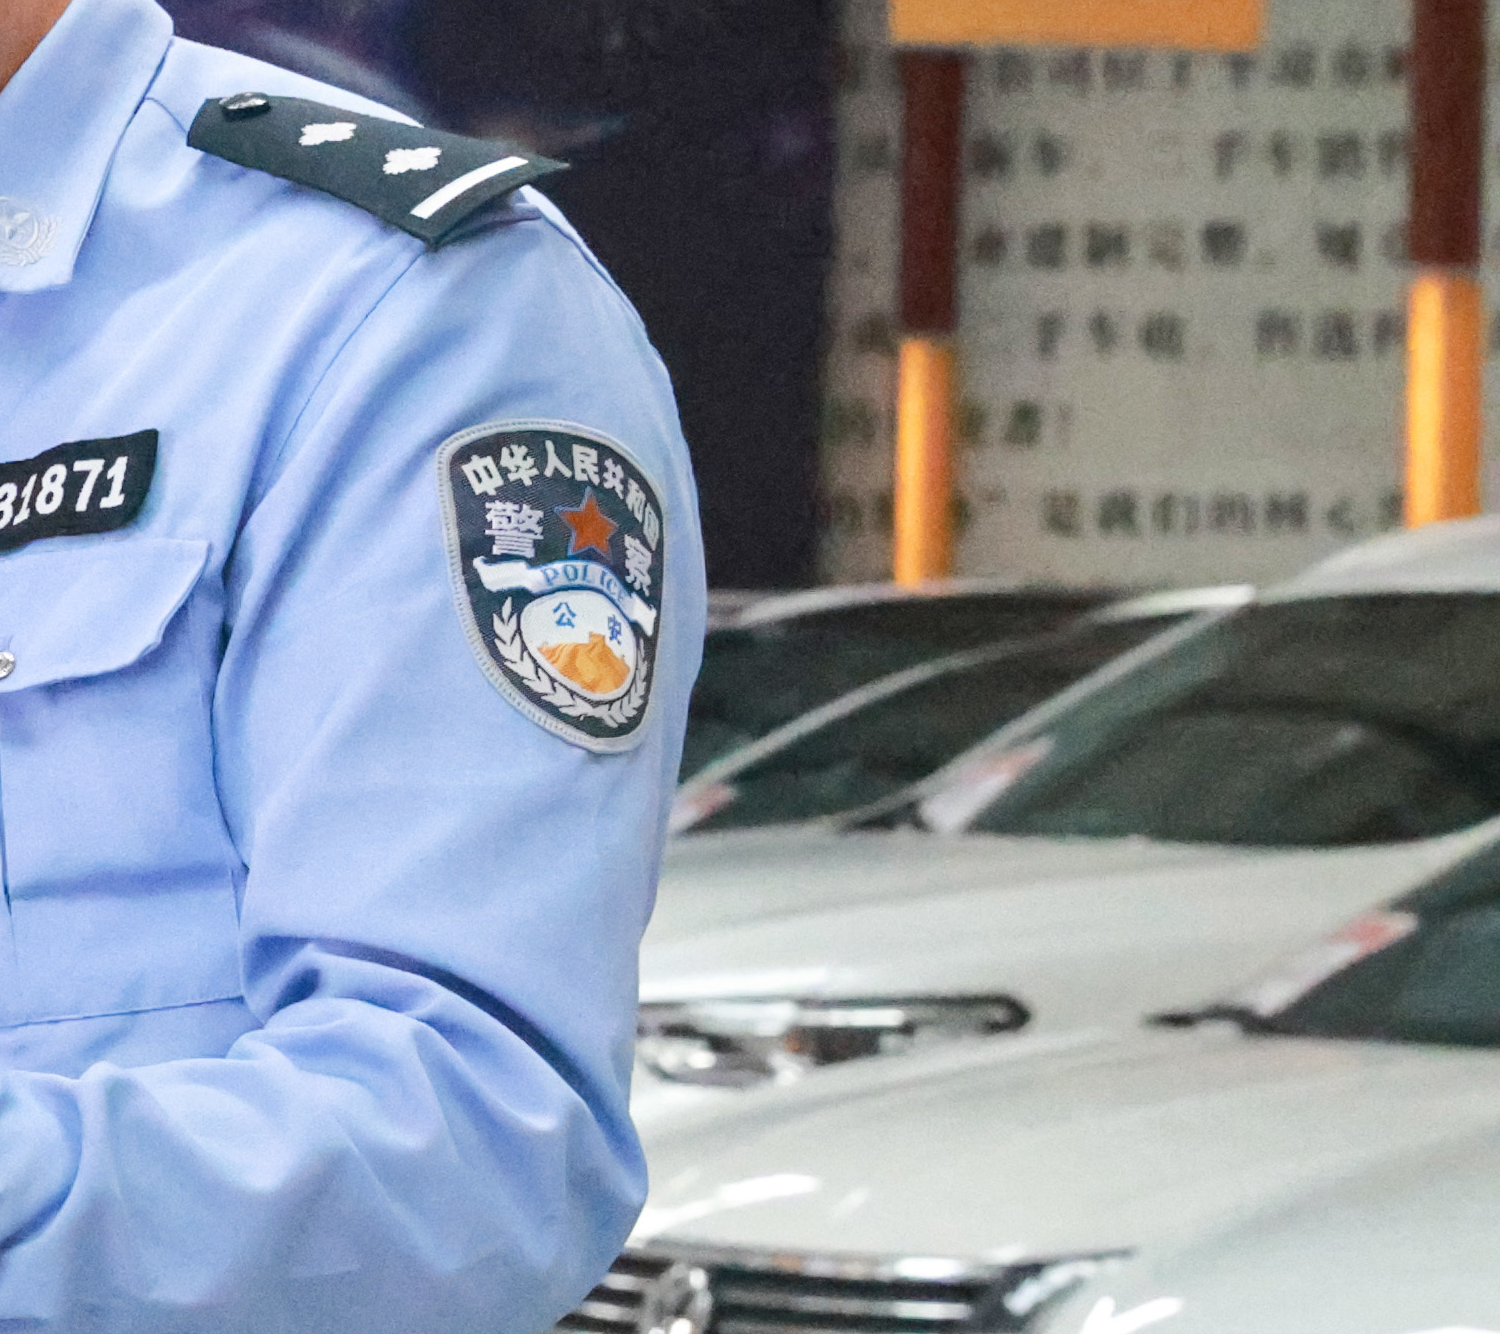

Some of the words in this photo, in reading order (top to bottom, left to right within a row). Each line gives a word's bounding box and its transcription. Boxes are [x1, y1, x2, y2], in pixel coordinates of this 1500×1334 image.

[460, 439, 660, 551] 中华人民共和国
[541, 563, 630, 603] POLICE
